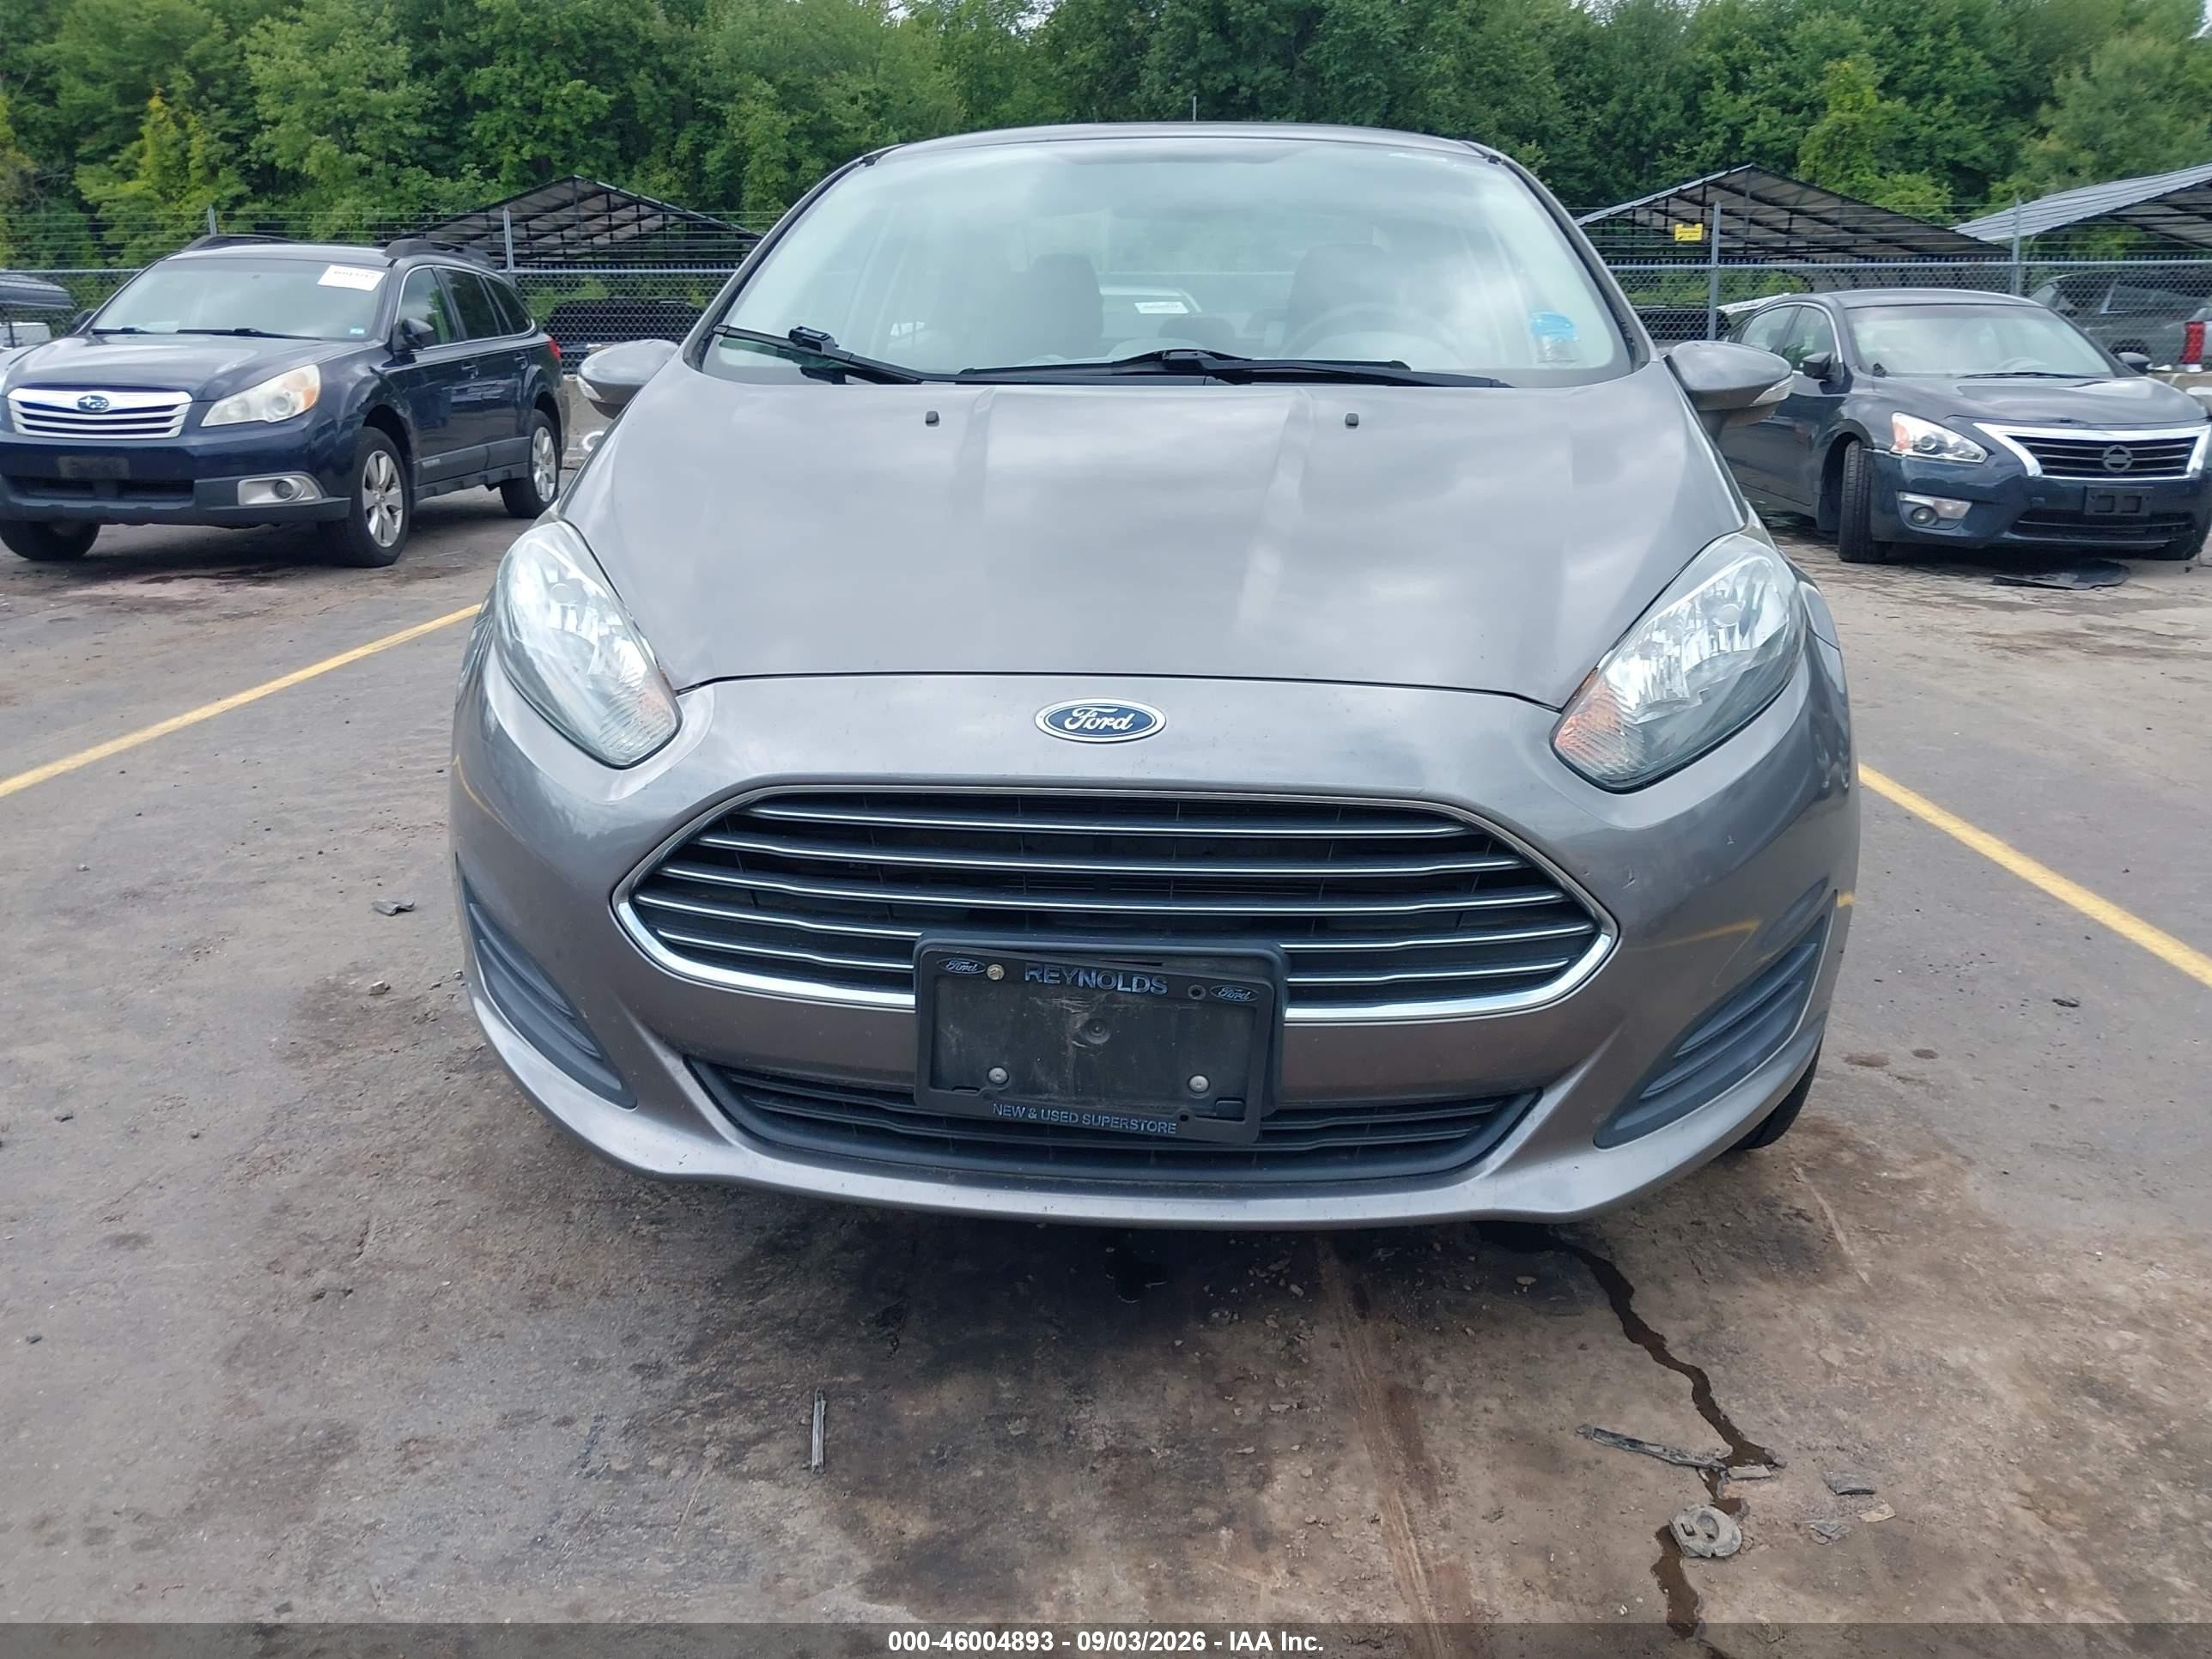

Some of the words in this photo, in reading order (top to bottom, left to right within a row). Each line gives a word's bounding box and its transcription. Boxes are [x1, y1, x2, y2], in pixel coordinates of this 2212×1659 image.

[1064, 707, 1135, 731] Ford
[945, 960, 978, 972] Ford
[1024, 963, 1169, 995] REYNOLDS
[1218, 987, 1251, 1000] Ford
[993, 1103, 1026, 1117] NEW
[1028, 1107, 1038, 1119] &
[1041, 1109, 1079, 1124] USED
[1082, 1114, 1177, 1134] SUPERSTORE
